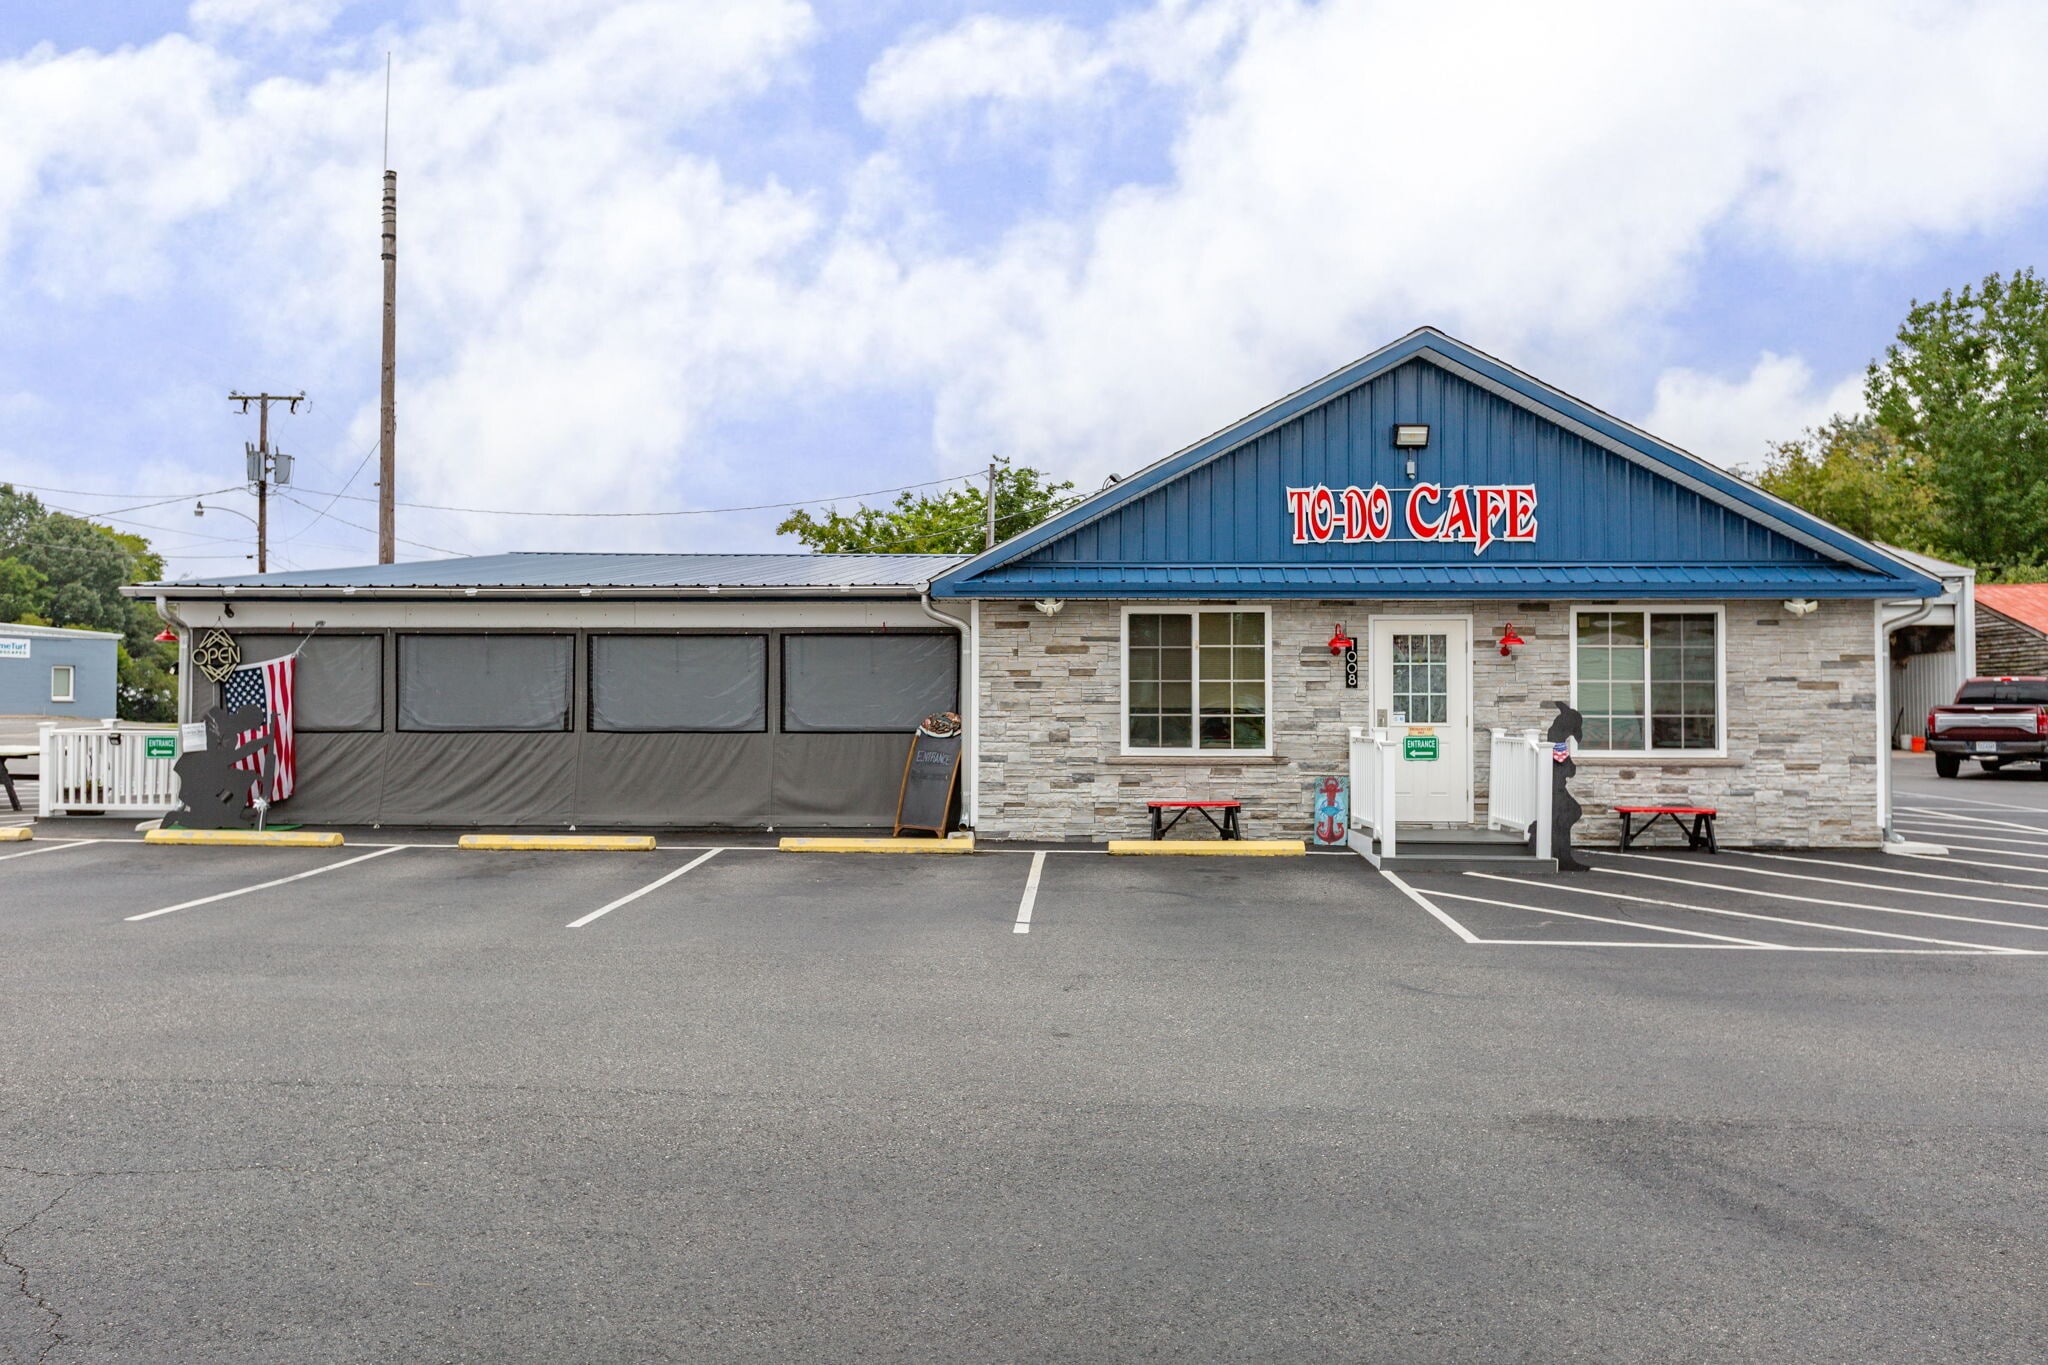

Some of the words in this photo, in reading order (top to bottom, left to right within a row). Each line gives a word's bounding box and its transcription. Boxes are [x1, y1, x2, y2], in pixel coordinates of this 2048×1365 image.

[1286, 482, 1392, 544] TO-DO
[1405, 482, 1538, 556] CAFE
[192, 646, 240, 665] OPEN
[1346, 639, 1357, 686] 1008
[148, 739, 175, 747] ENTRANCE
[1407, 740, 1436, 748] ENTRANCE
[916, 750, 951, 766] ENTRANCE
